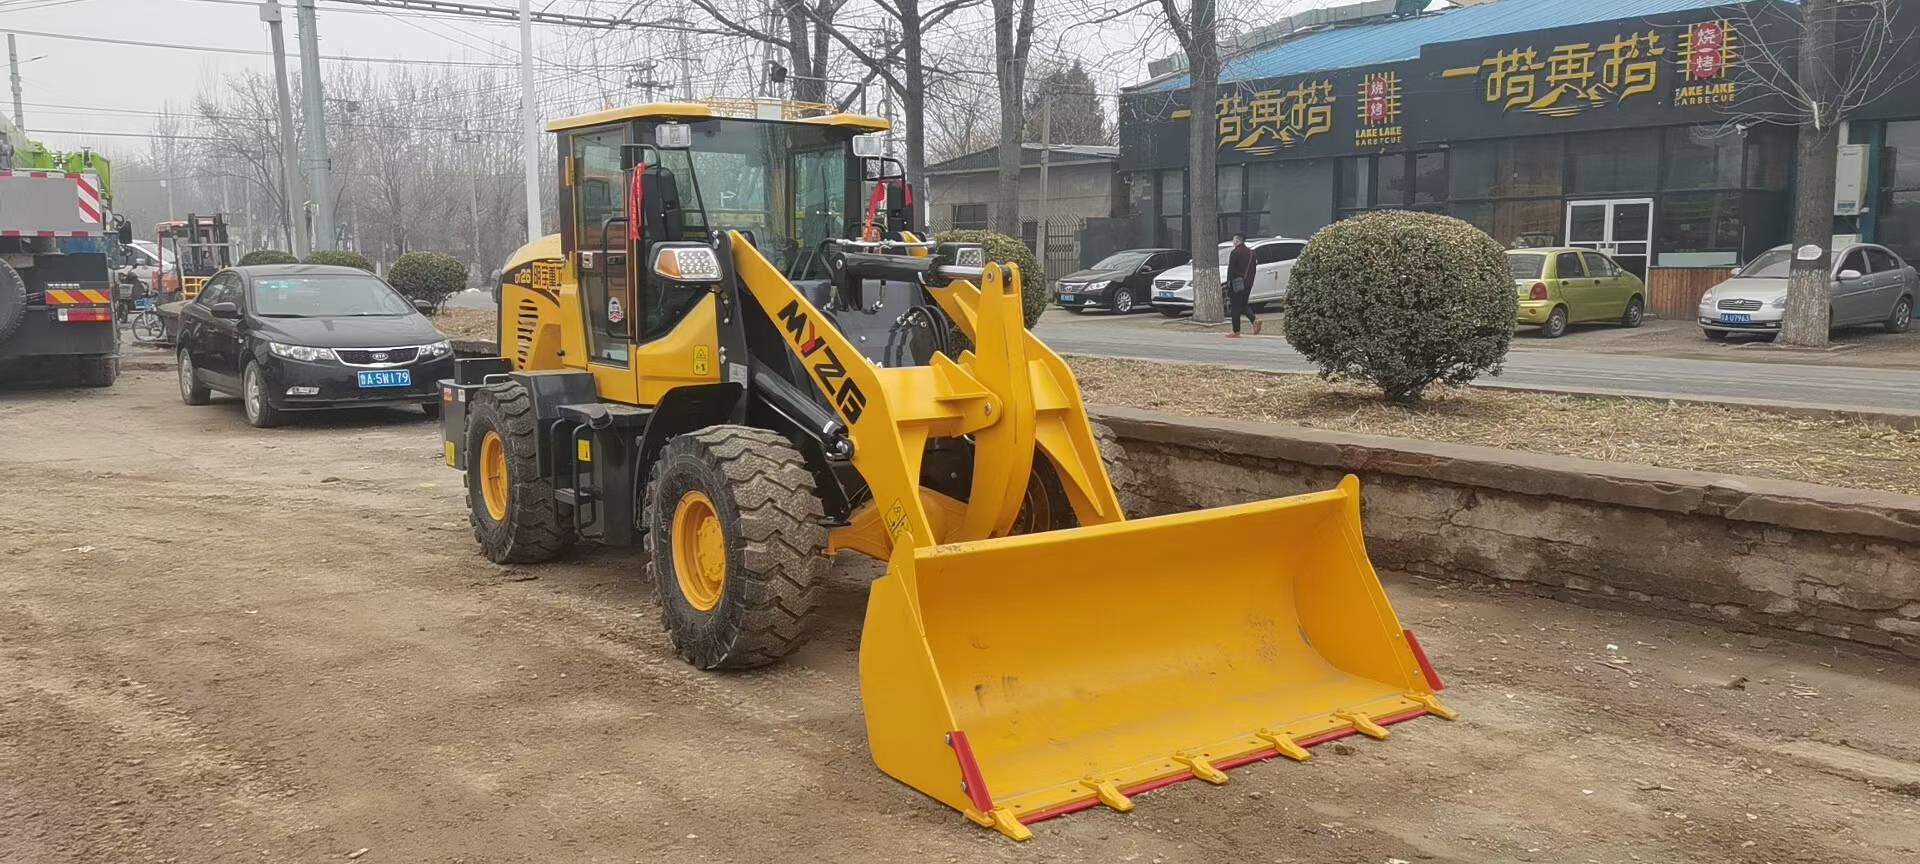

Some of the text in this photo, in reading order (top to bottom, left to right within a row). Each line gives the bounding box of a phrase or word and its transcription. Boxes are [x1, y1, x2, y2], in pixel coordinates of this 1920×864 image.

[1705, 82, 1736, 95] LAKE
[1355, 126, 1403, 139] LAKE LAKE
[776, 298, 868, 425] MYZG
